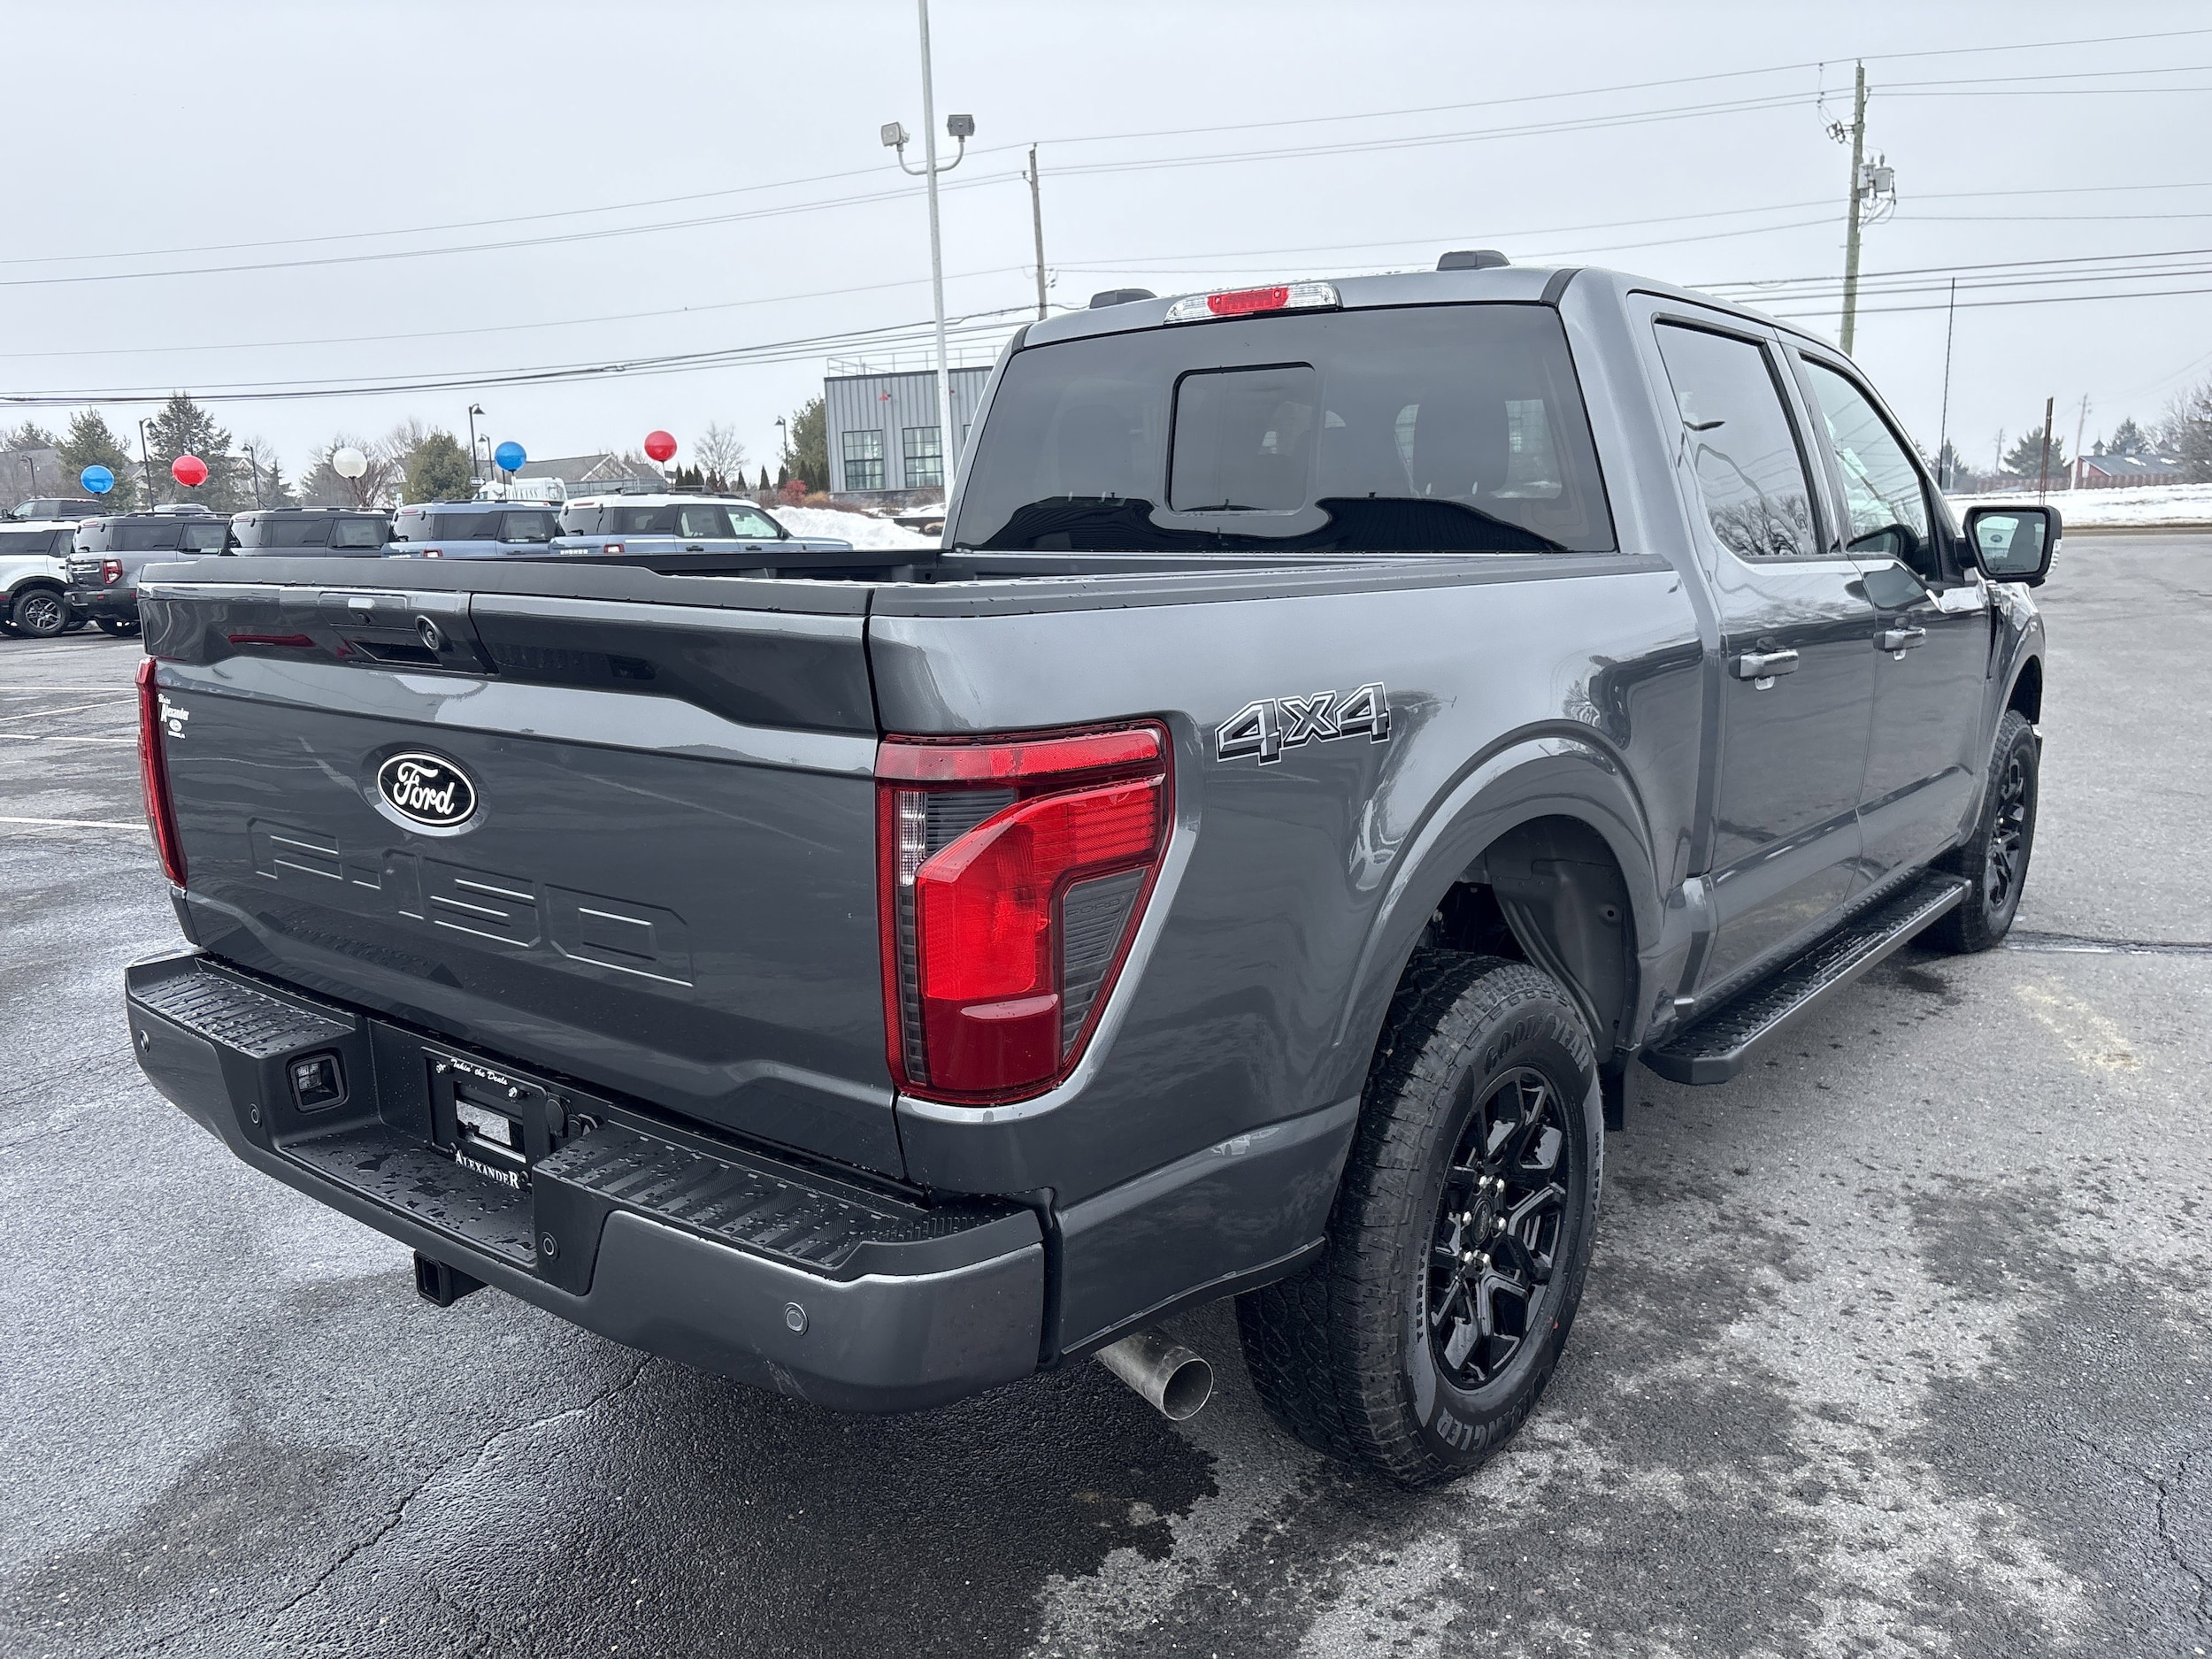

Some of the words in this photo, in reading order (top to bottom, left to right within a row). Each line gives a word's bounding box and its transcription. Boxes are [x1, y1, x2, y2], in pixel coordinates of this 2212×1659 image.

[393, 762, 455, 815] Ford
[1484, 1011, 1590, 1075] GOODYEAR
[474, 1068, 486, 1078] the
[487, 1071, 508, 1086] Deals
